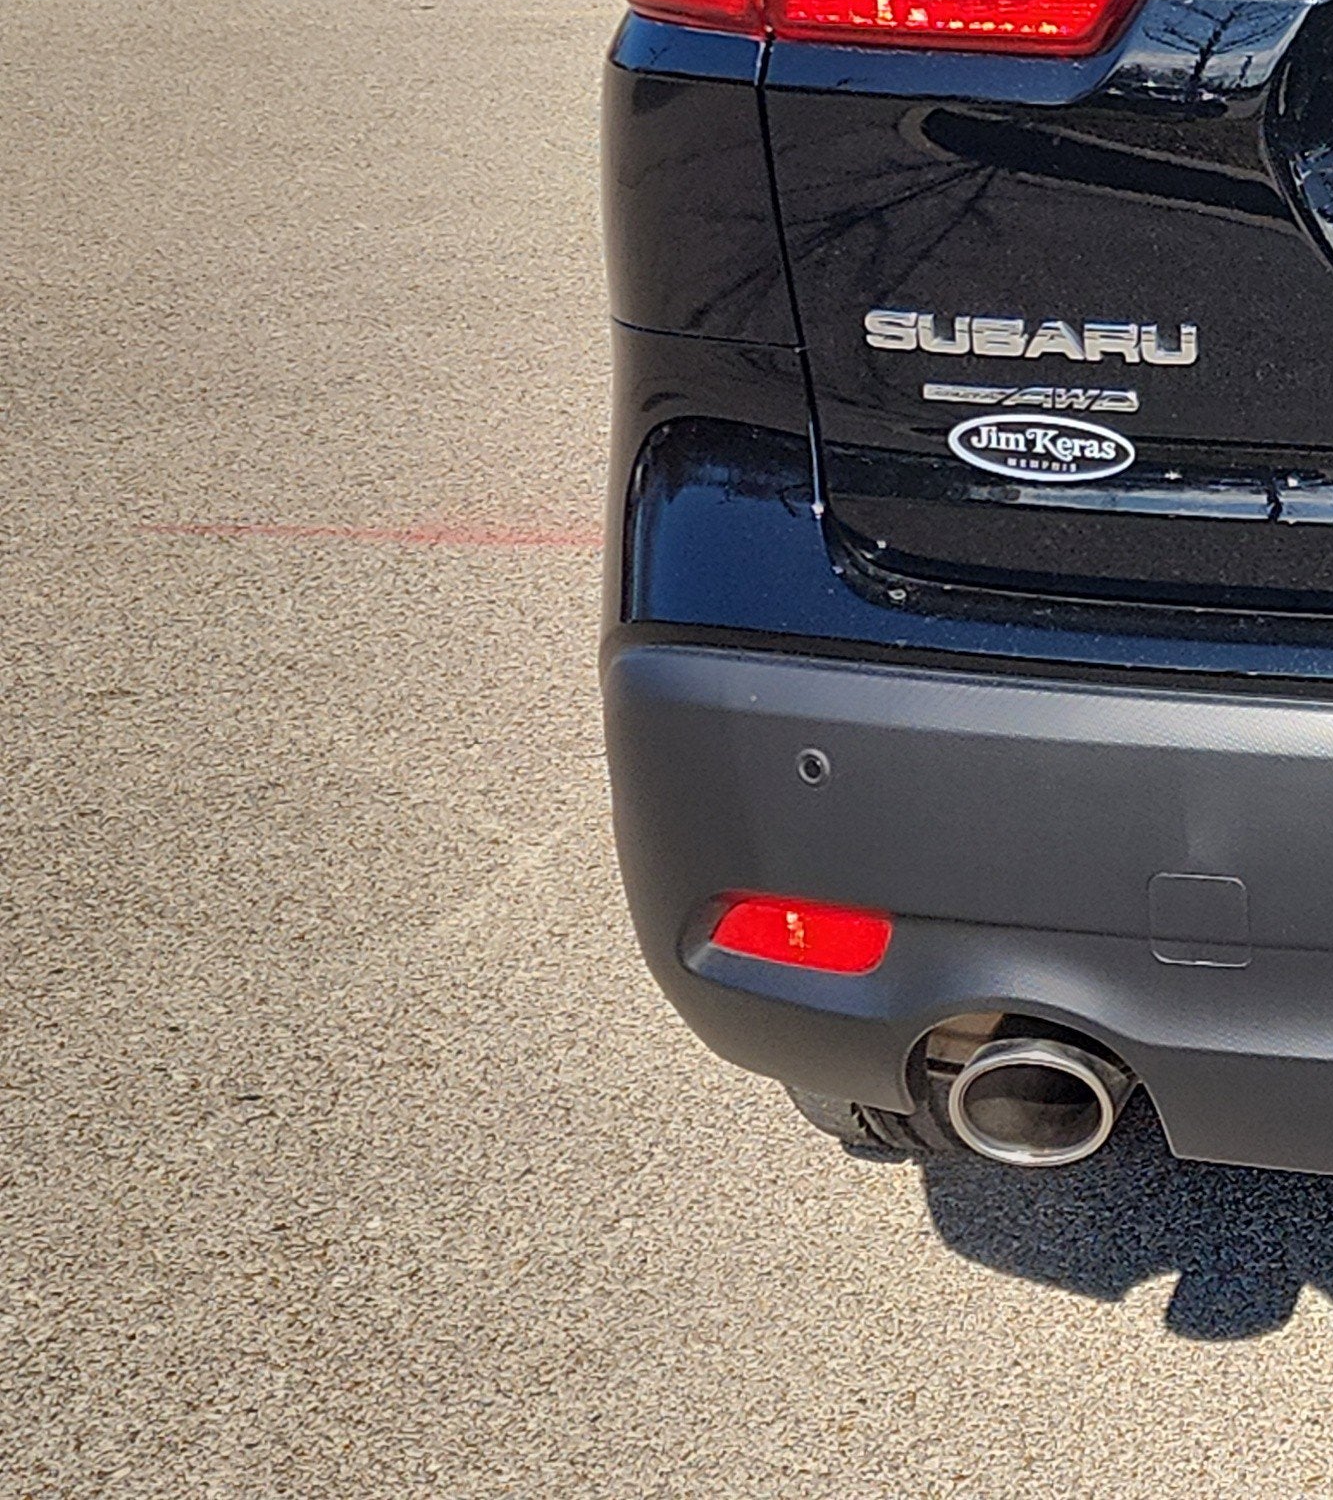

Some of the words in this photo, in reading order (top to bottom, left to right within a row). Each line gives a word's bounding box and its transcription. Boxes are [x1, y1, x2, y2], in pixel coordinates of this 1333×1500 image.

[864, 309, 1199, 366] SUBARU
[1002, 386, 1140, 412] AWD
[970, 426, 1026, 452] Jim
[1025, 428, 1116, 462] Keras
[1007, 457, 1077, 473] MEMPHIS
